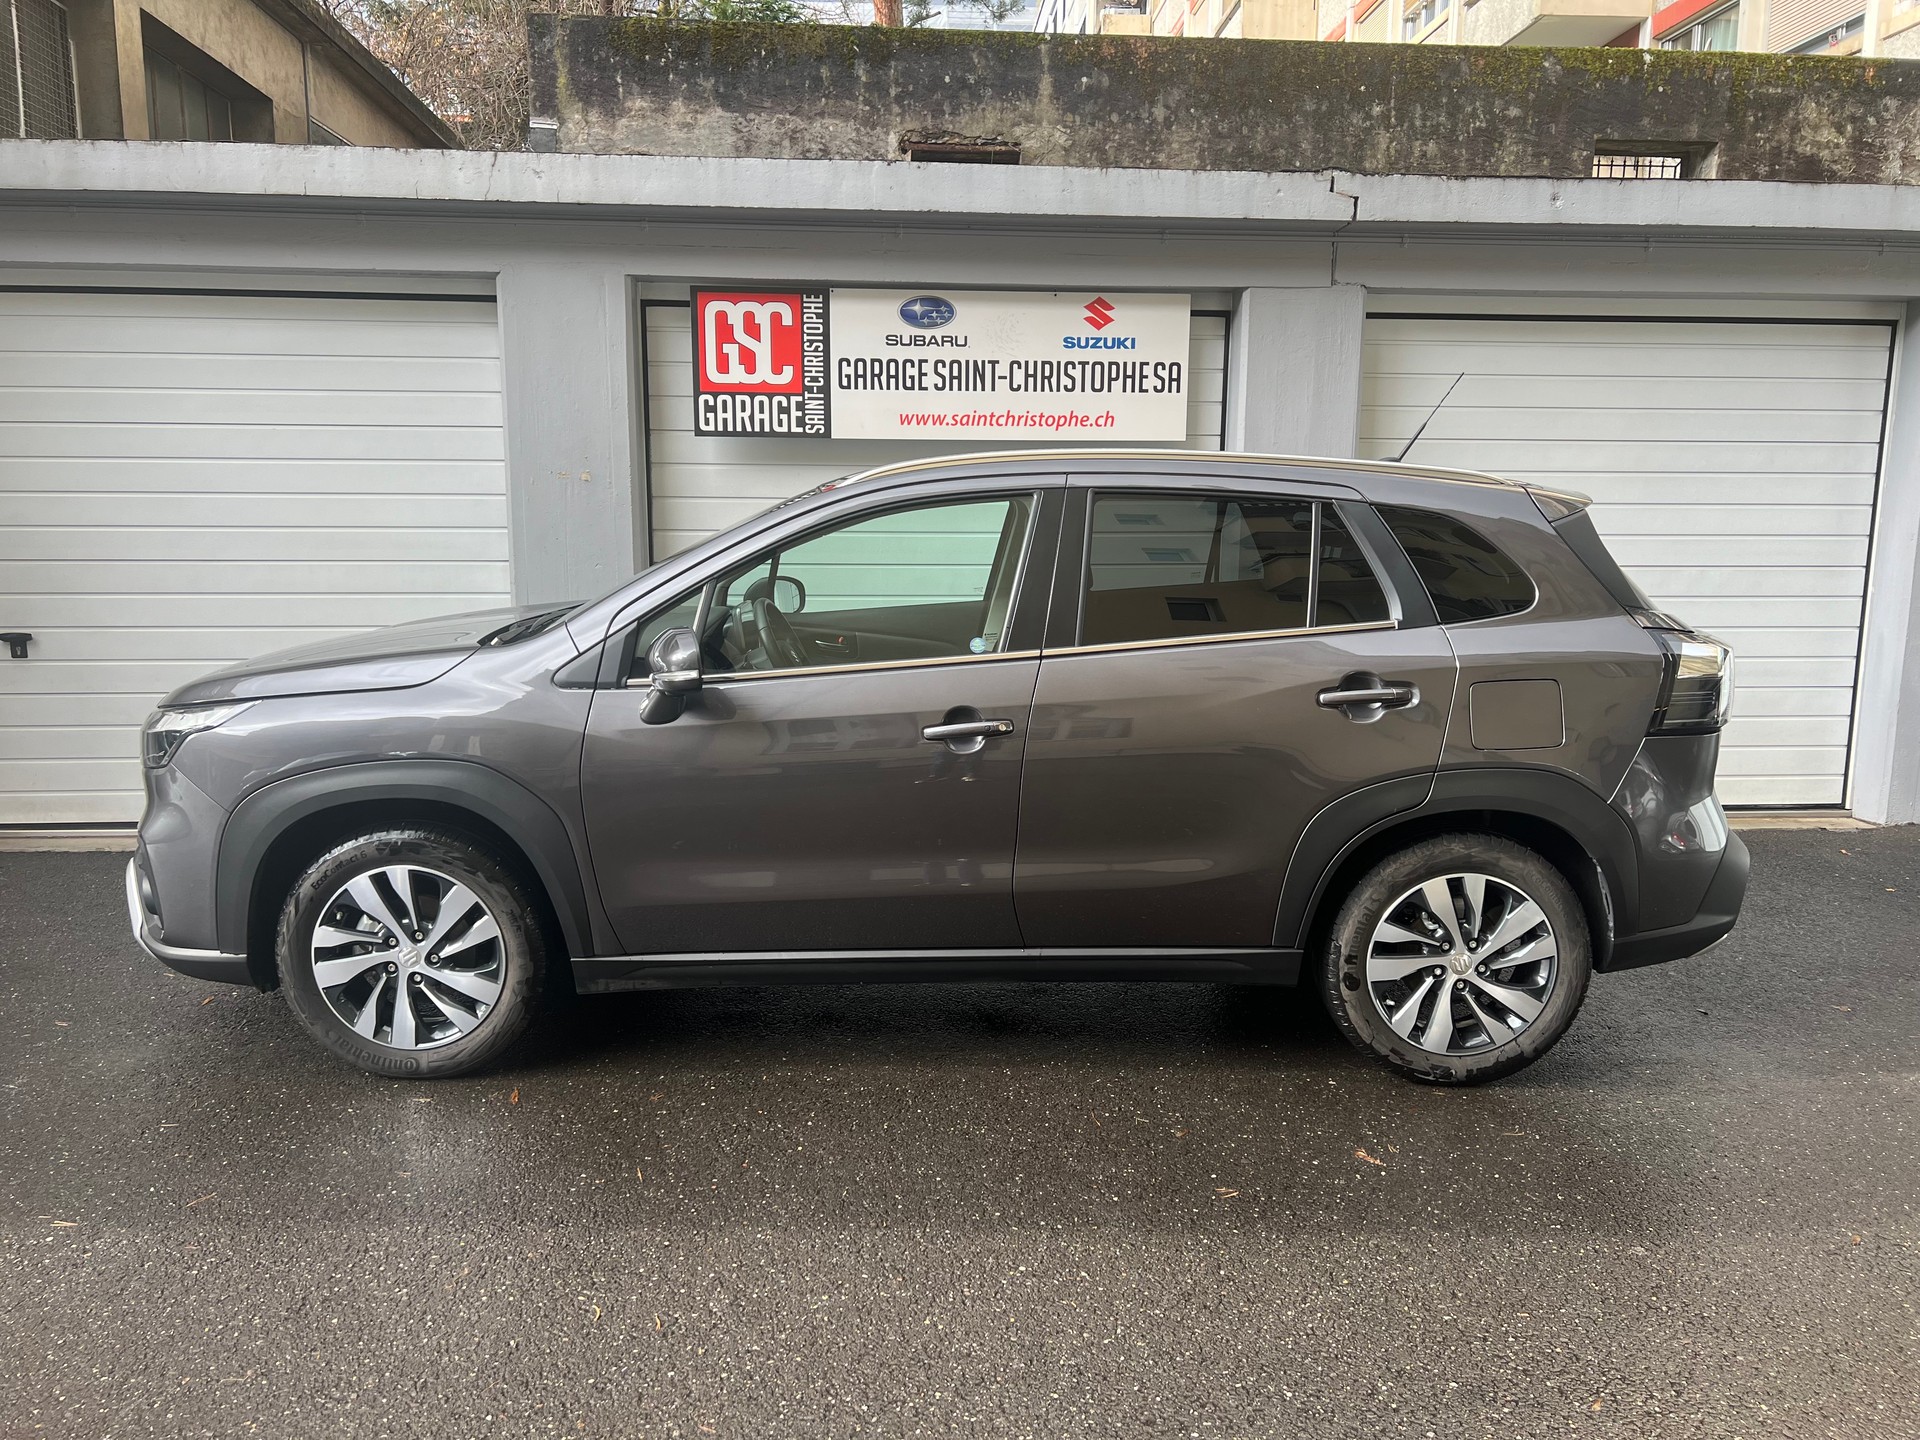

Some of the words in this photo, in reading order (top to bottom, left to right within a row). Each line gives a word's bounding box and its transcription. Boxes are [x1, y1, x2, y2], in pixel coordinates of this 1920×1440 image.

[704, 300, 794, 385] GSC
[885, 334, 968, 348] SUBARU
[1063, 336, 1136, 350] SUZUKI
[803, 294, 825, 434] SAINT-CHRISTOPHE
[838, 357, 929, 391] GARAGE
[933, 359, 1149, 393] SAINT-CHRISTOPHE
[1153, 361, 1182, 393] SA
[698, 394, 804, 433] GARAGE
[899, 409, 1115, 432] www.saintchristophe.ch
